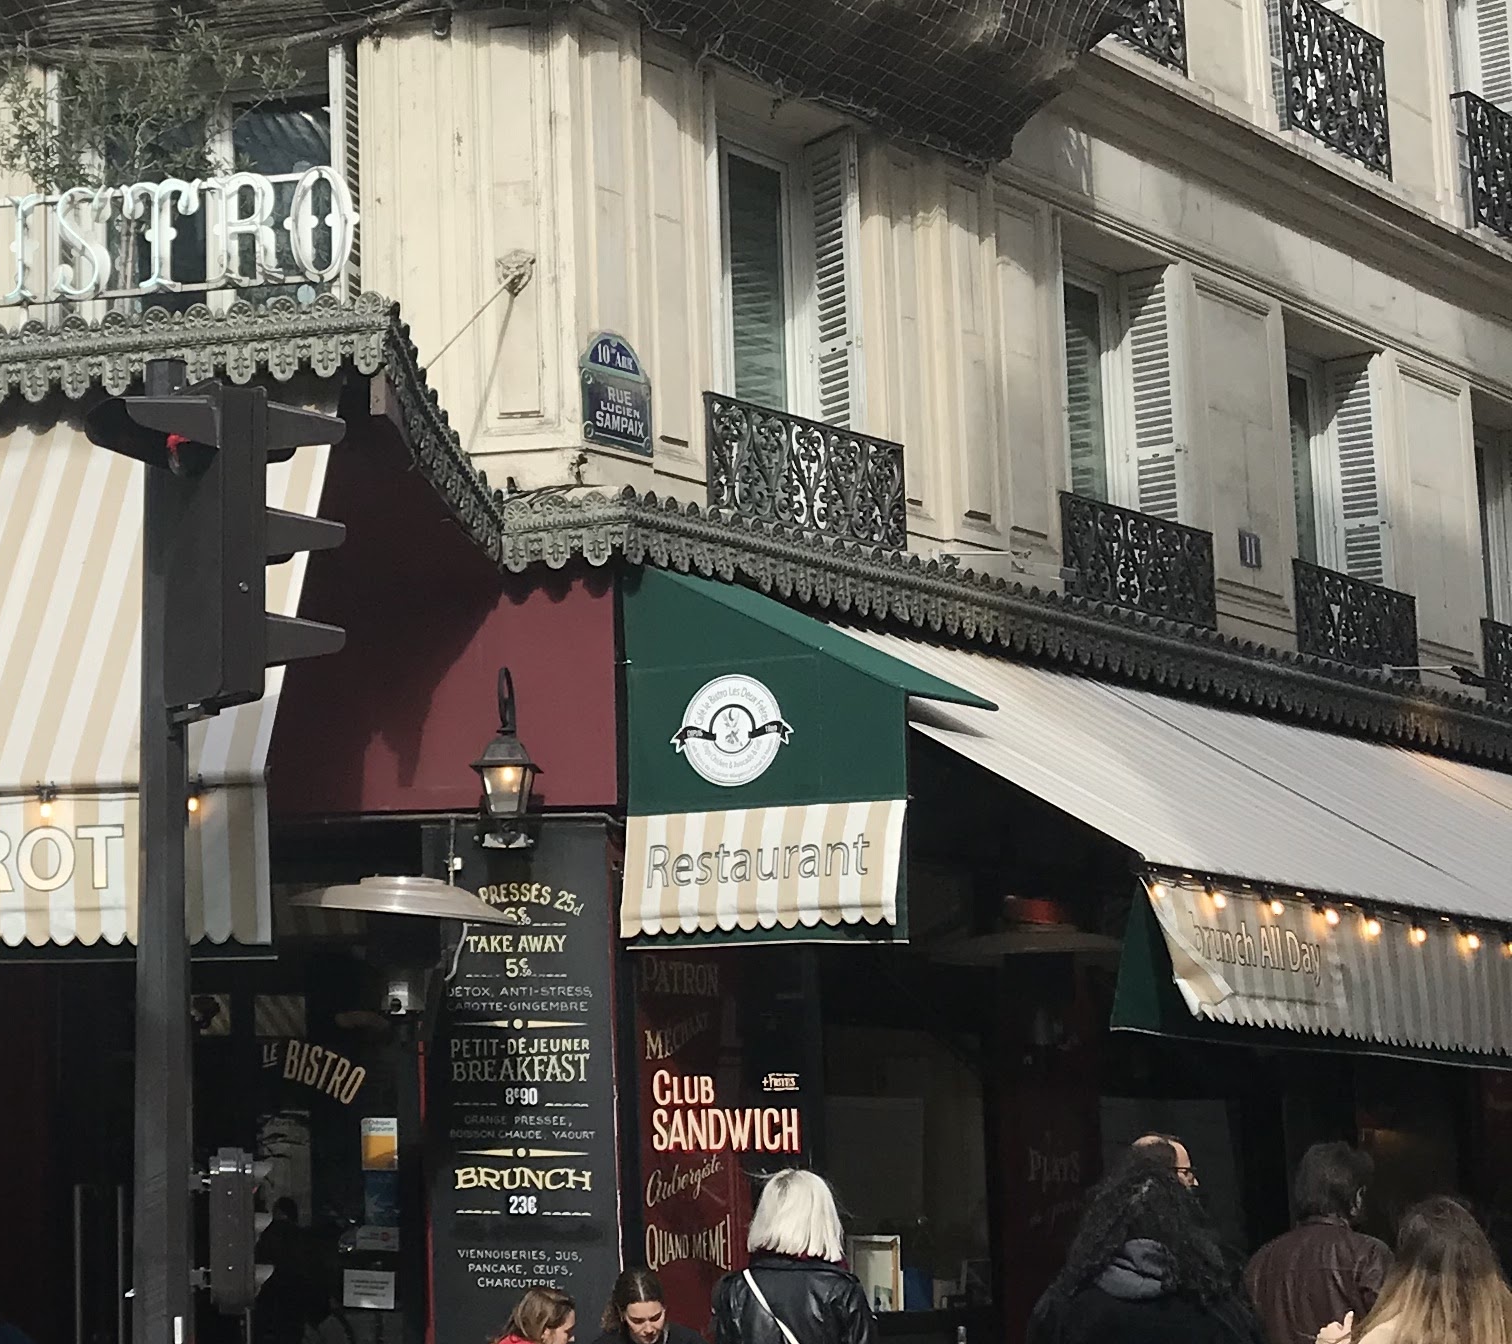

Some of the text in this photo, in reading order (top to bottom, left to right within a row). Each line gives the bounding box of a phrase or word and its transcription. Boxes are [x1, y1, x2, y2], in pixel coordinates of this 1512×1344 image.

[607, 386, 633, 407] RUE
[600, 400, 641, 419] LUCIEN
[595, 410, 645, 439] SAMPAIX
[1245, 536, 1257, 565] 11
[646, 832, 871, 889] Restaurant
[478, 882, 552, 905] PRESSÉS
[465, 934, 567, 953] TAKE AWAY
[1260, 925, 1286, 971] All
[1285, 929, 1322, 987] Day
[640, 955, 720, 997] PATRON
[499, 986, 593, 998] ANTI-STRESS,
[450, 1036, 590, 1057] PETIT-DÉJEUNER
[263, 1039, 367, 1105] LE BISTRO
[451, 1053, 591, 1083] BREAKFAST
[653, 1069, 715, 1107] CLUB
[552, 1130, 596, 1140] YAOURT
[652, 1108, 800, 1152] SANDWICH
[454, 1167, 592, 1192] BRUNCH
[508, 1196, 538, 1215] 23€
[646, 1213, 733, 1272] QUAND MÊME!
[457, 1249, 584, 1263] VIENNOISERIES, JUS,
[467, 1263, 528, 1276] PANCAKE,
